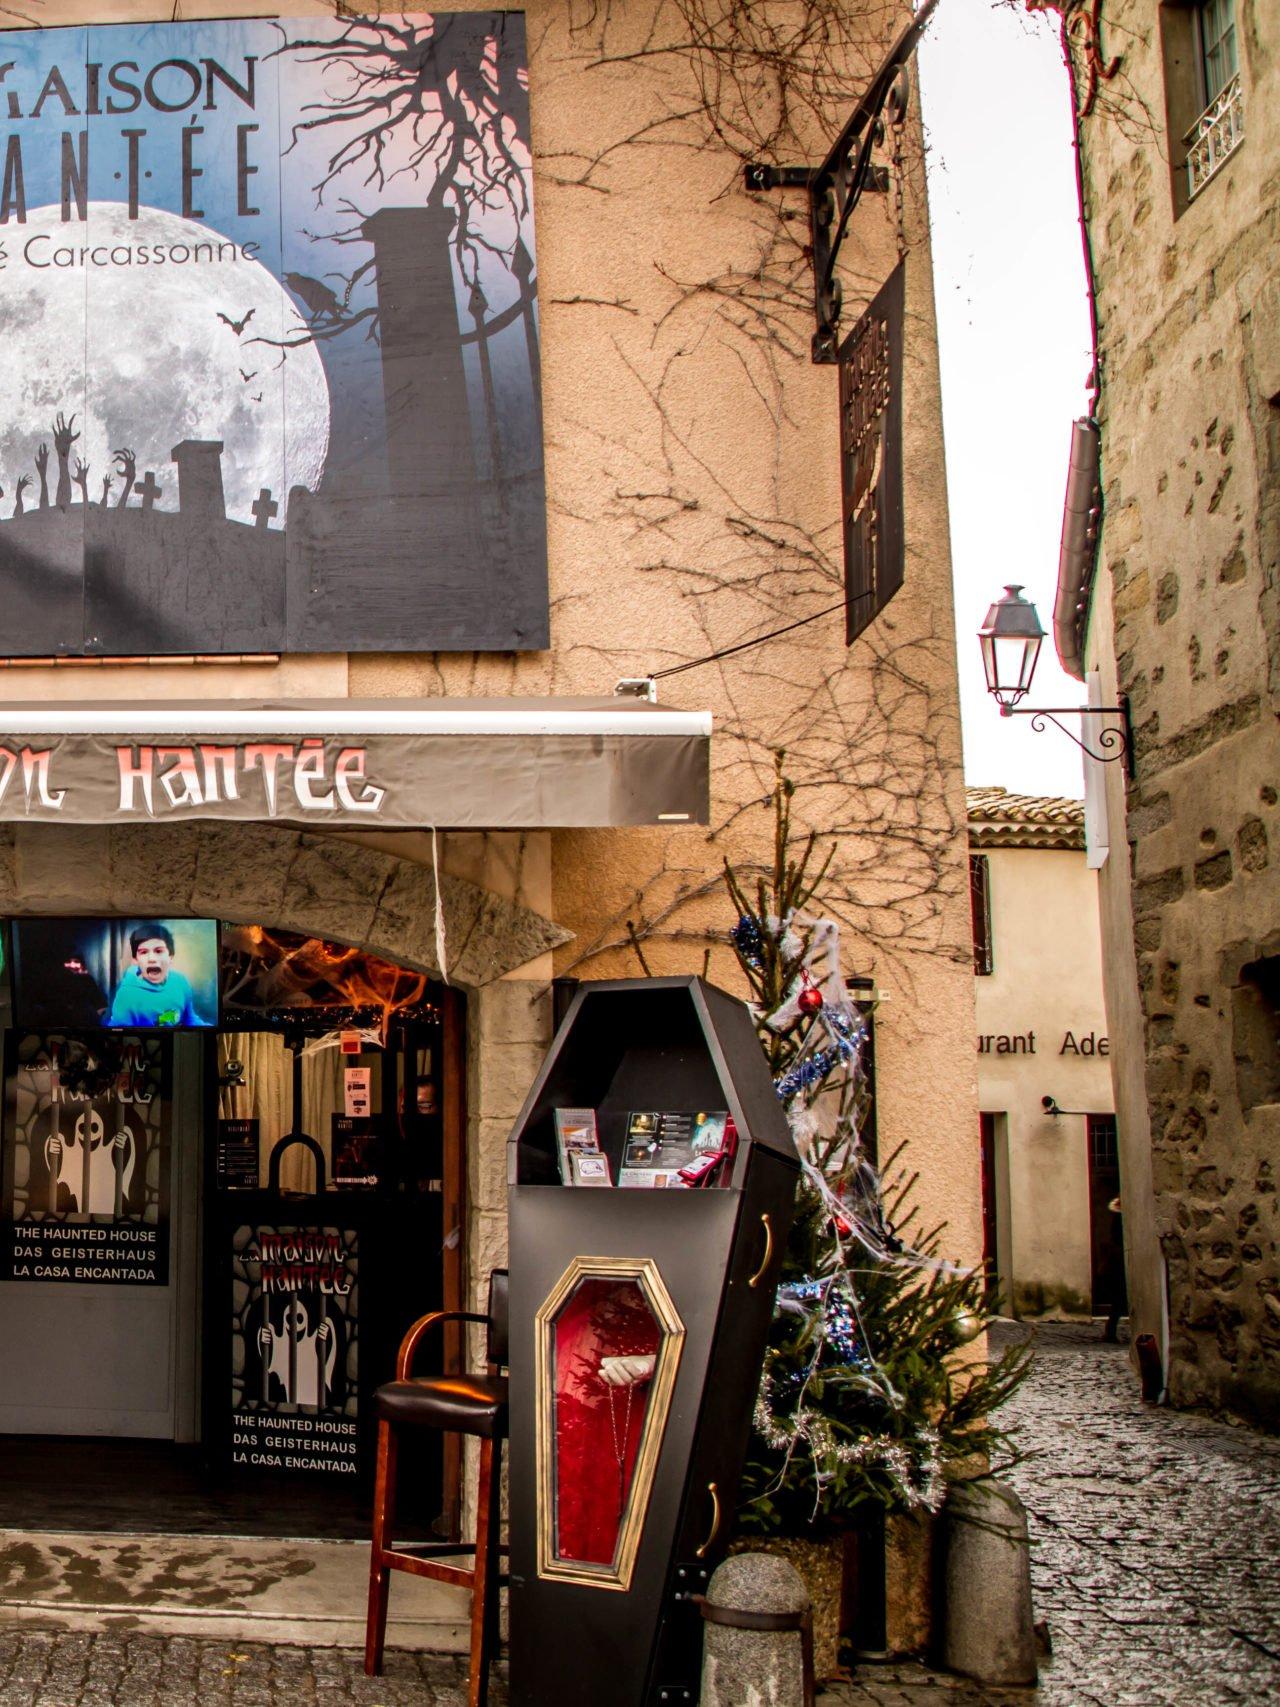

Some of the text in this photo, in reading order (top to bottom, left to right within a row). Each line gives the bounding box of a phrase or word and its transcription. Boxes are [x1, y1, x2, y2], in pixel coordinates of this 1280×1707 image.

[23, 235, 261, 268] Carcassonne
[14, 1227, 156, 1242] THE HAUNTED HOUSE
[14, 1246, 156, 1261] DAS GEISTERHAUS
[13, 1265, 156, 1280] LA CASA ENCANTADA
[233, 1414, 357, 1435] THE HAUNTED HOUSE
[233, 1433, 357, 1454] DAS GEISTERHAUS
[233, 1451, 357, 1473] LA CASA ENCANTADA
